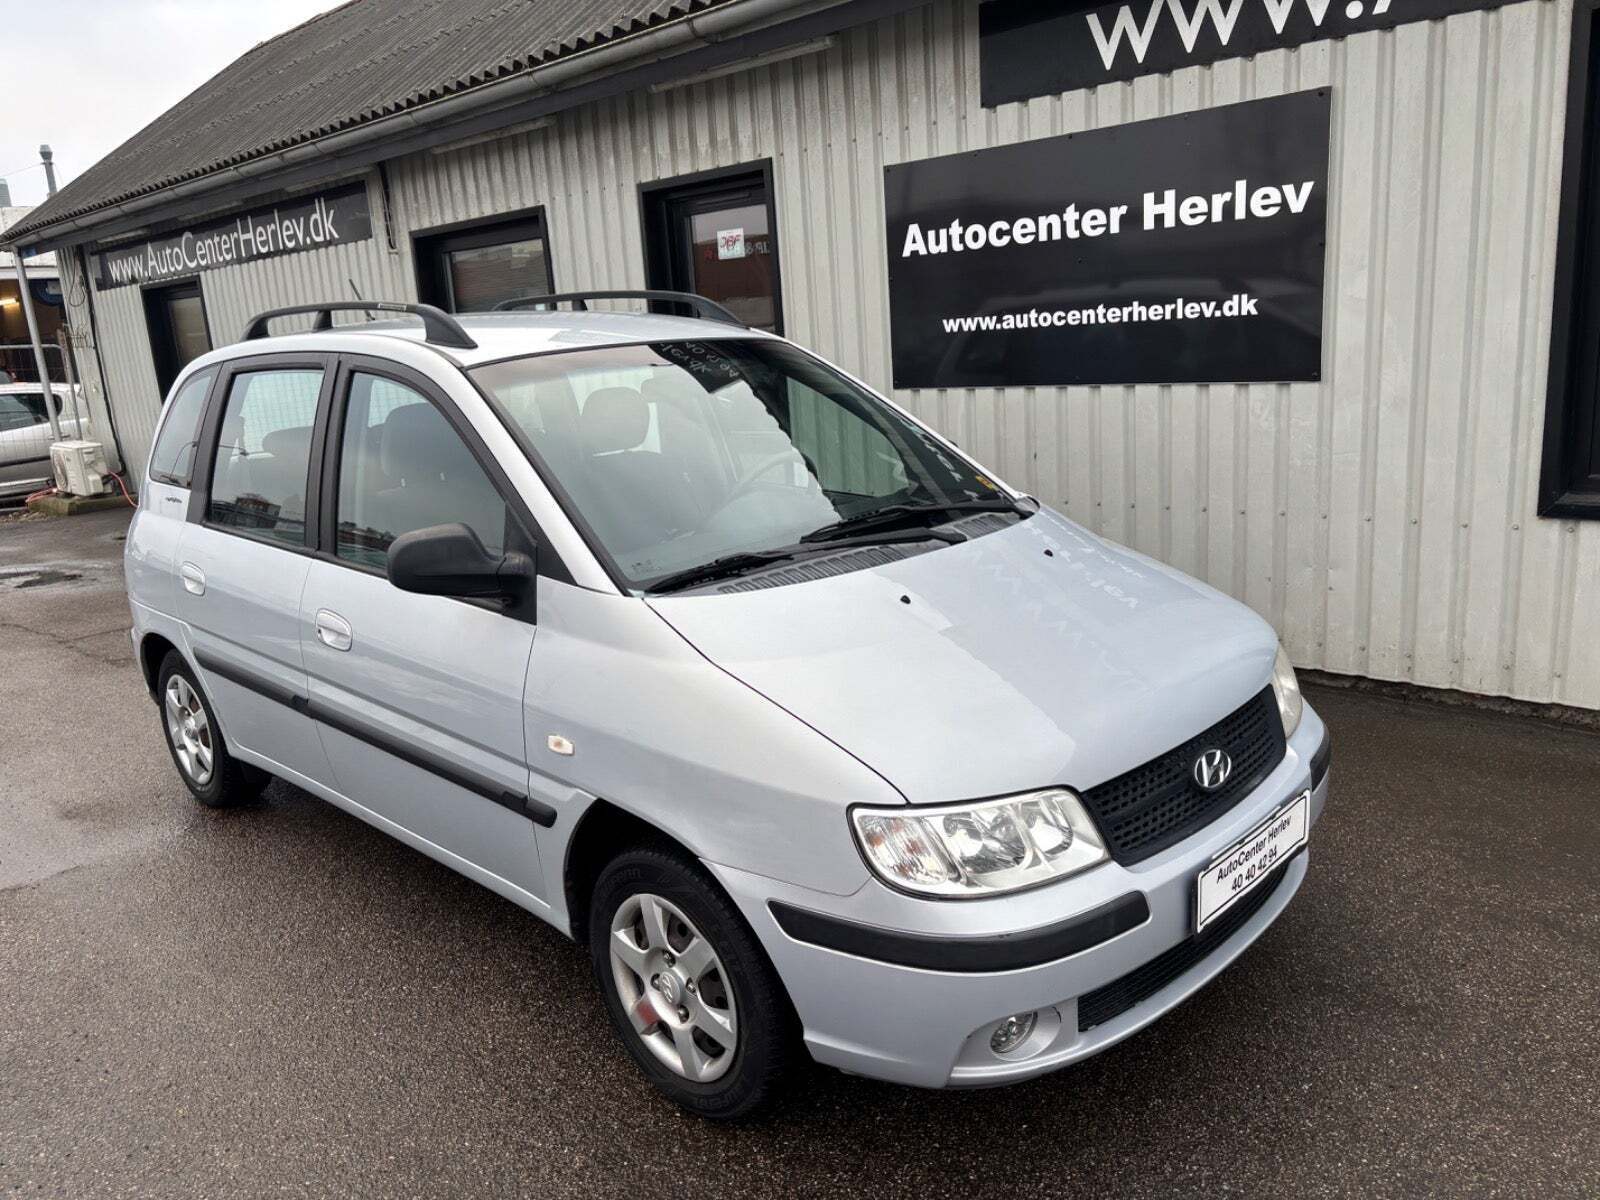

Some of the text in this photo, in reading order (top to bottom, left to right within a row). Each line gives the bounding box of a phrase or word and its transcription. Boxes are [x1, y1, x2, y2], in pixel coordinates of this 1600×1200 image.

[107, 197, 339, 284] www.AutoCenterHerlev.dk
[902, 179, 1315, 257] Autocenter Herlev
[943, 293, 1258, 333] www.autocenterherlev.dk
[1216, 816, 1292, 884] AutoCenter Herlev
[1231, 845, 1278, 892] 40 40 42 94
